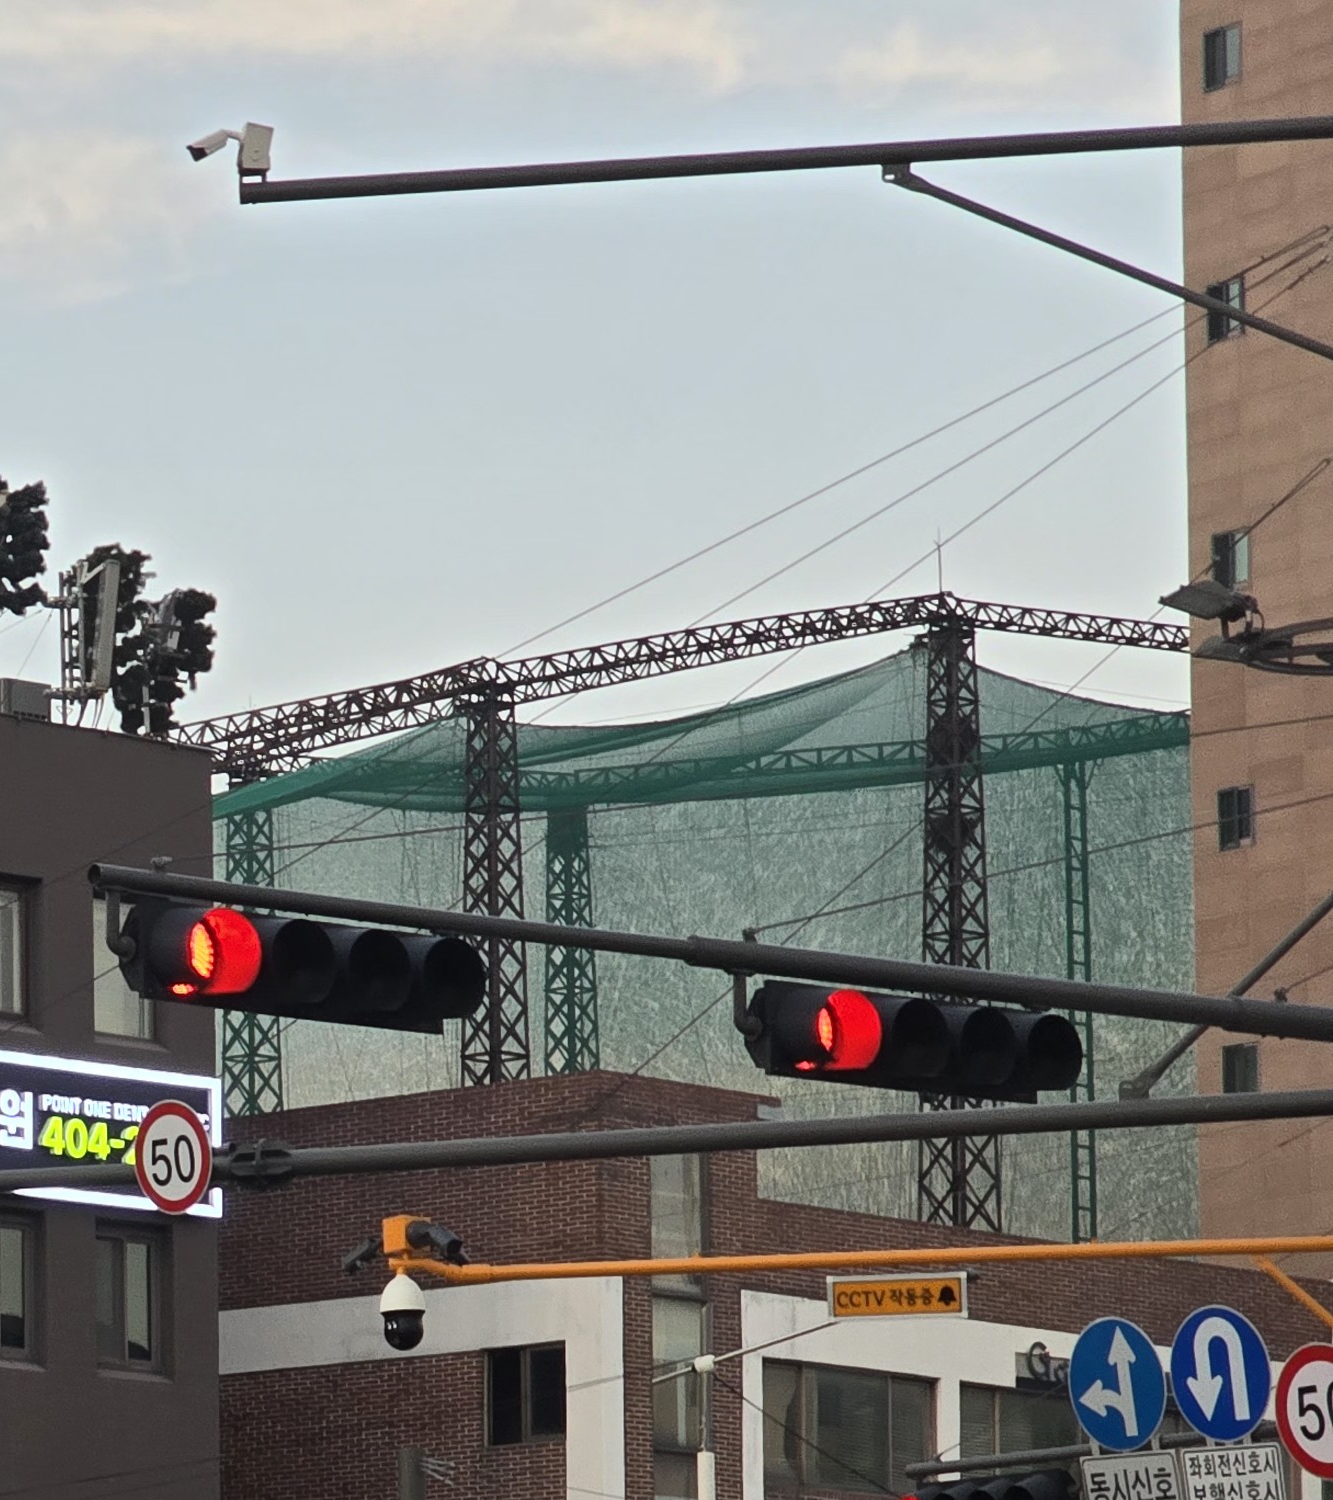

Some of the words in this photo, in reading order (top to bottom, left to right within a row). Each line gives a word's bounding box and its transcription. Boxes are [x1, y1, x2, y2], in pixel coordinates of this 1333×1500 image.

[39, 1094, 82, 1115] POINT
[83, 1098, 112, 1119] ONE
[39, 1115, 139, 1166] 404-2
[151, 1134, 196, 1187] 50
[836, 1290, 885, 1308] CCTV
[1297, 1383, 1333, 1443] 5
